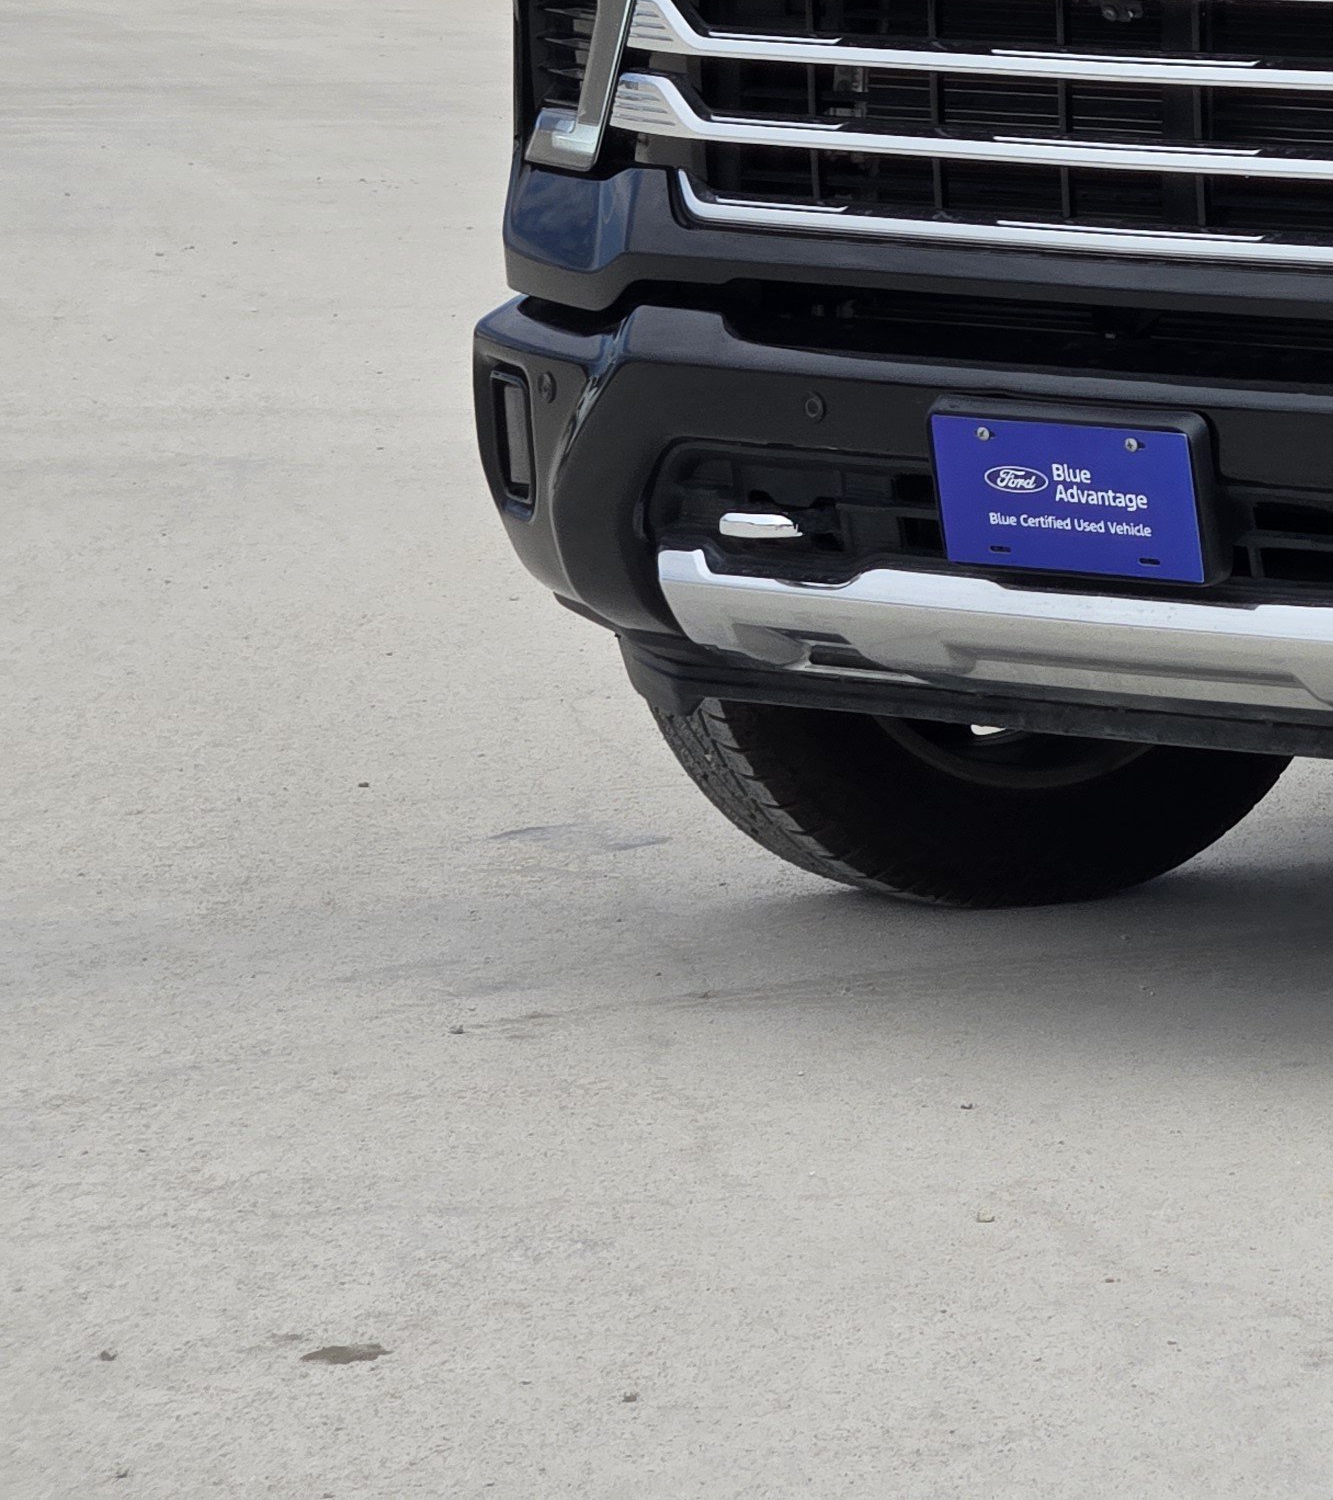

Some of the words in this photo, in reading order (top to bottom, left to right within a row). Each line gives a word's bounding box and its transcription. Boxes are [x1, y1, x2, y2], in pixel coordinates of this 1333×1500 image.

[995, 468, 1037, 490] Ford
[1051, 463, 1092, 484] Blue
[1055, 484, 1149, 512] Advantage
[988, 512, 1018, 526] Blue
[1019, 513, 1072, 531] Certified
[1074, 518, 1105, 533] Used
[1107, 521, 1152, 537] Vehicle
